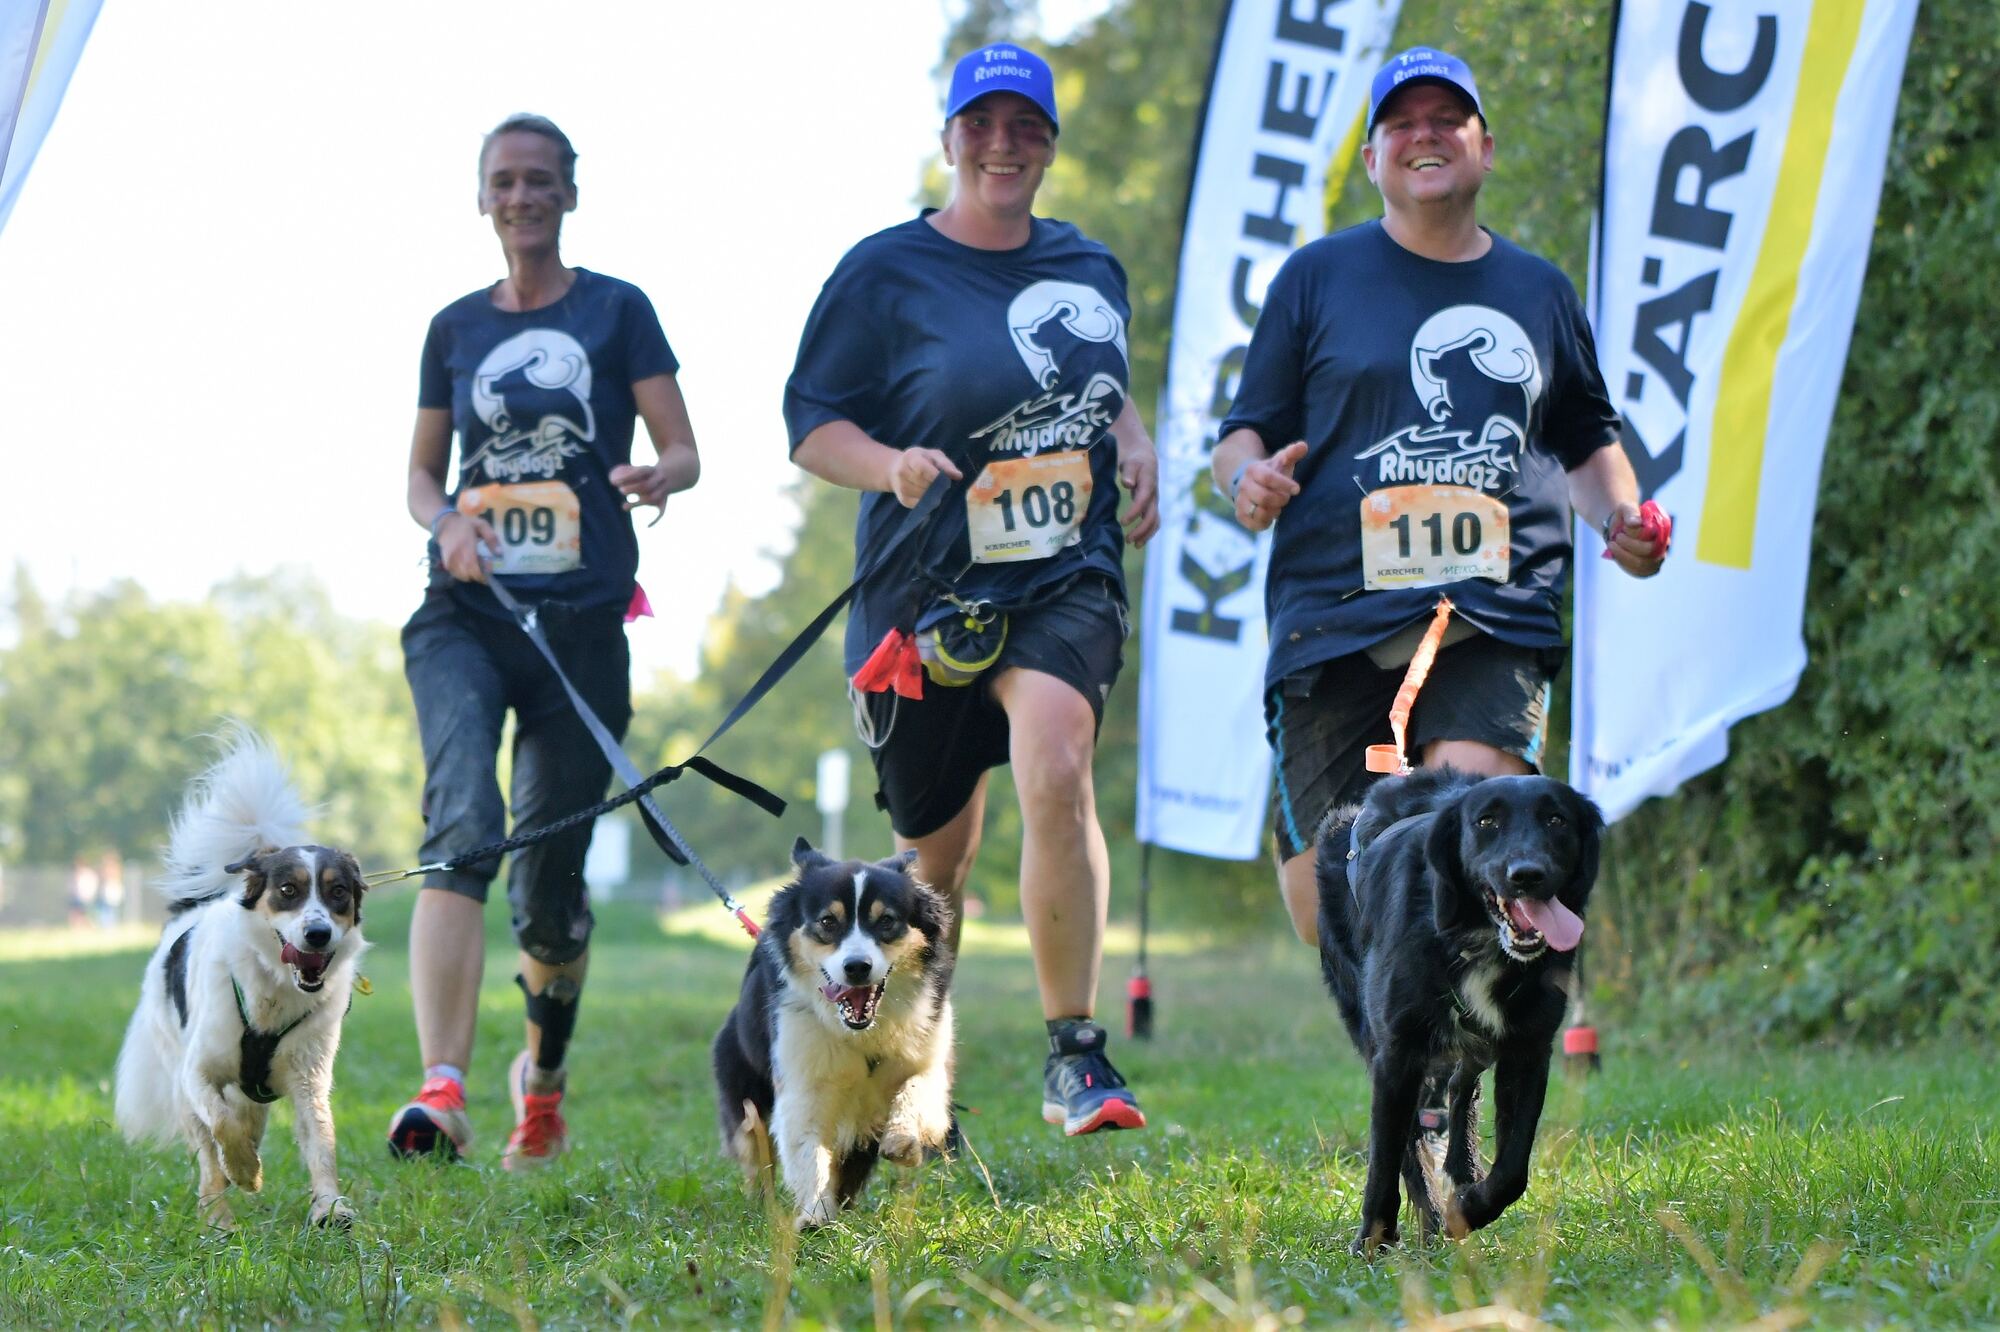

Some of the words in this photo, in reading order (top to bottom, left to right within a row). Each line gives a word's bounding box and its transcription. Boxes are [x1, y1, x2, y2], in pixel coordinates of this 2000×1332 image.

[1378, 452, 1500, 493] Rhydogz
[993, 480, 1075, 533] 108
[1389, 511, 1482, 559] 110
